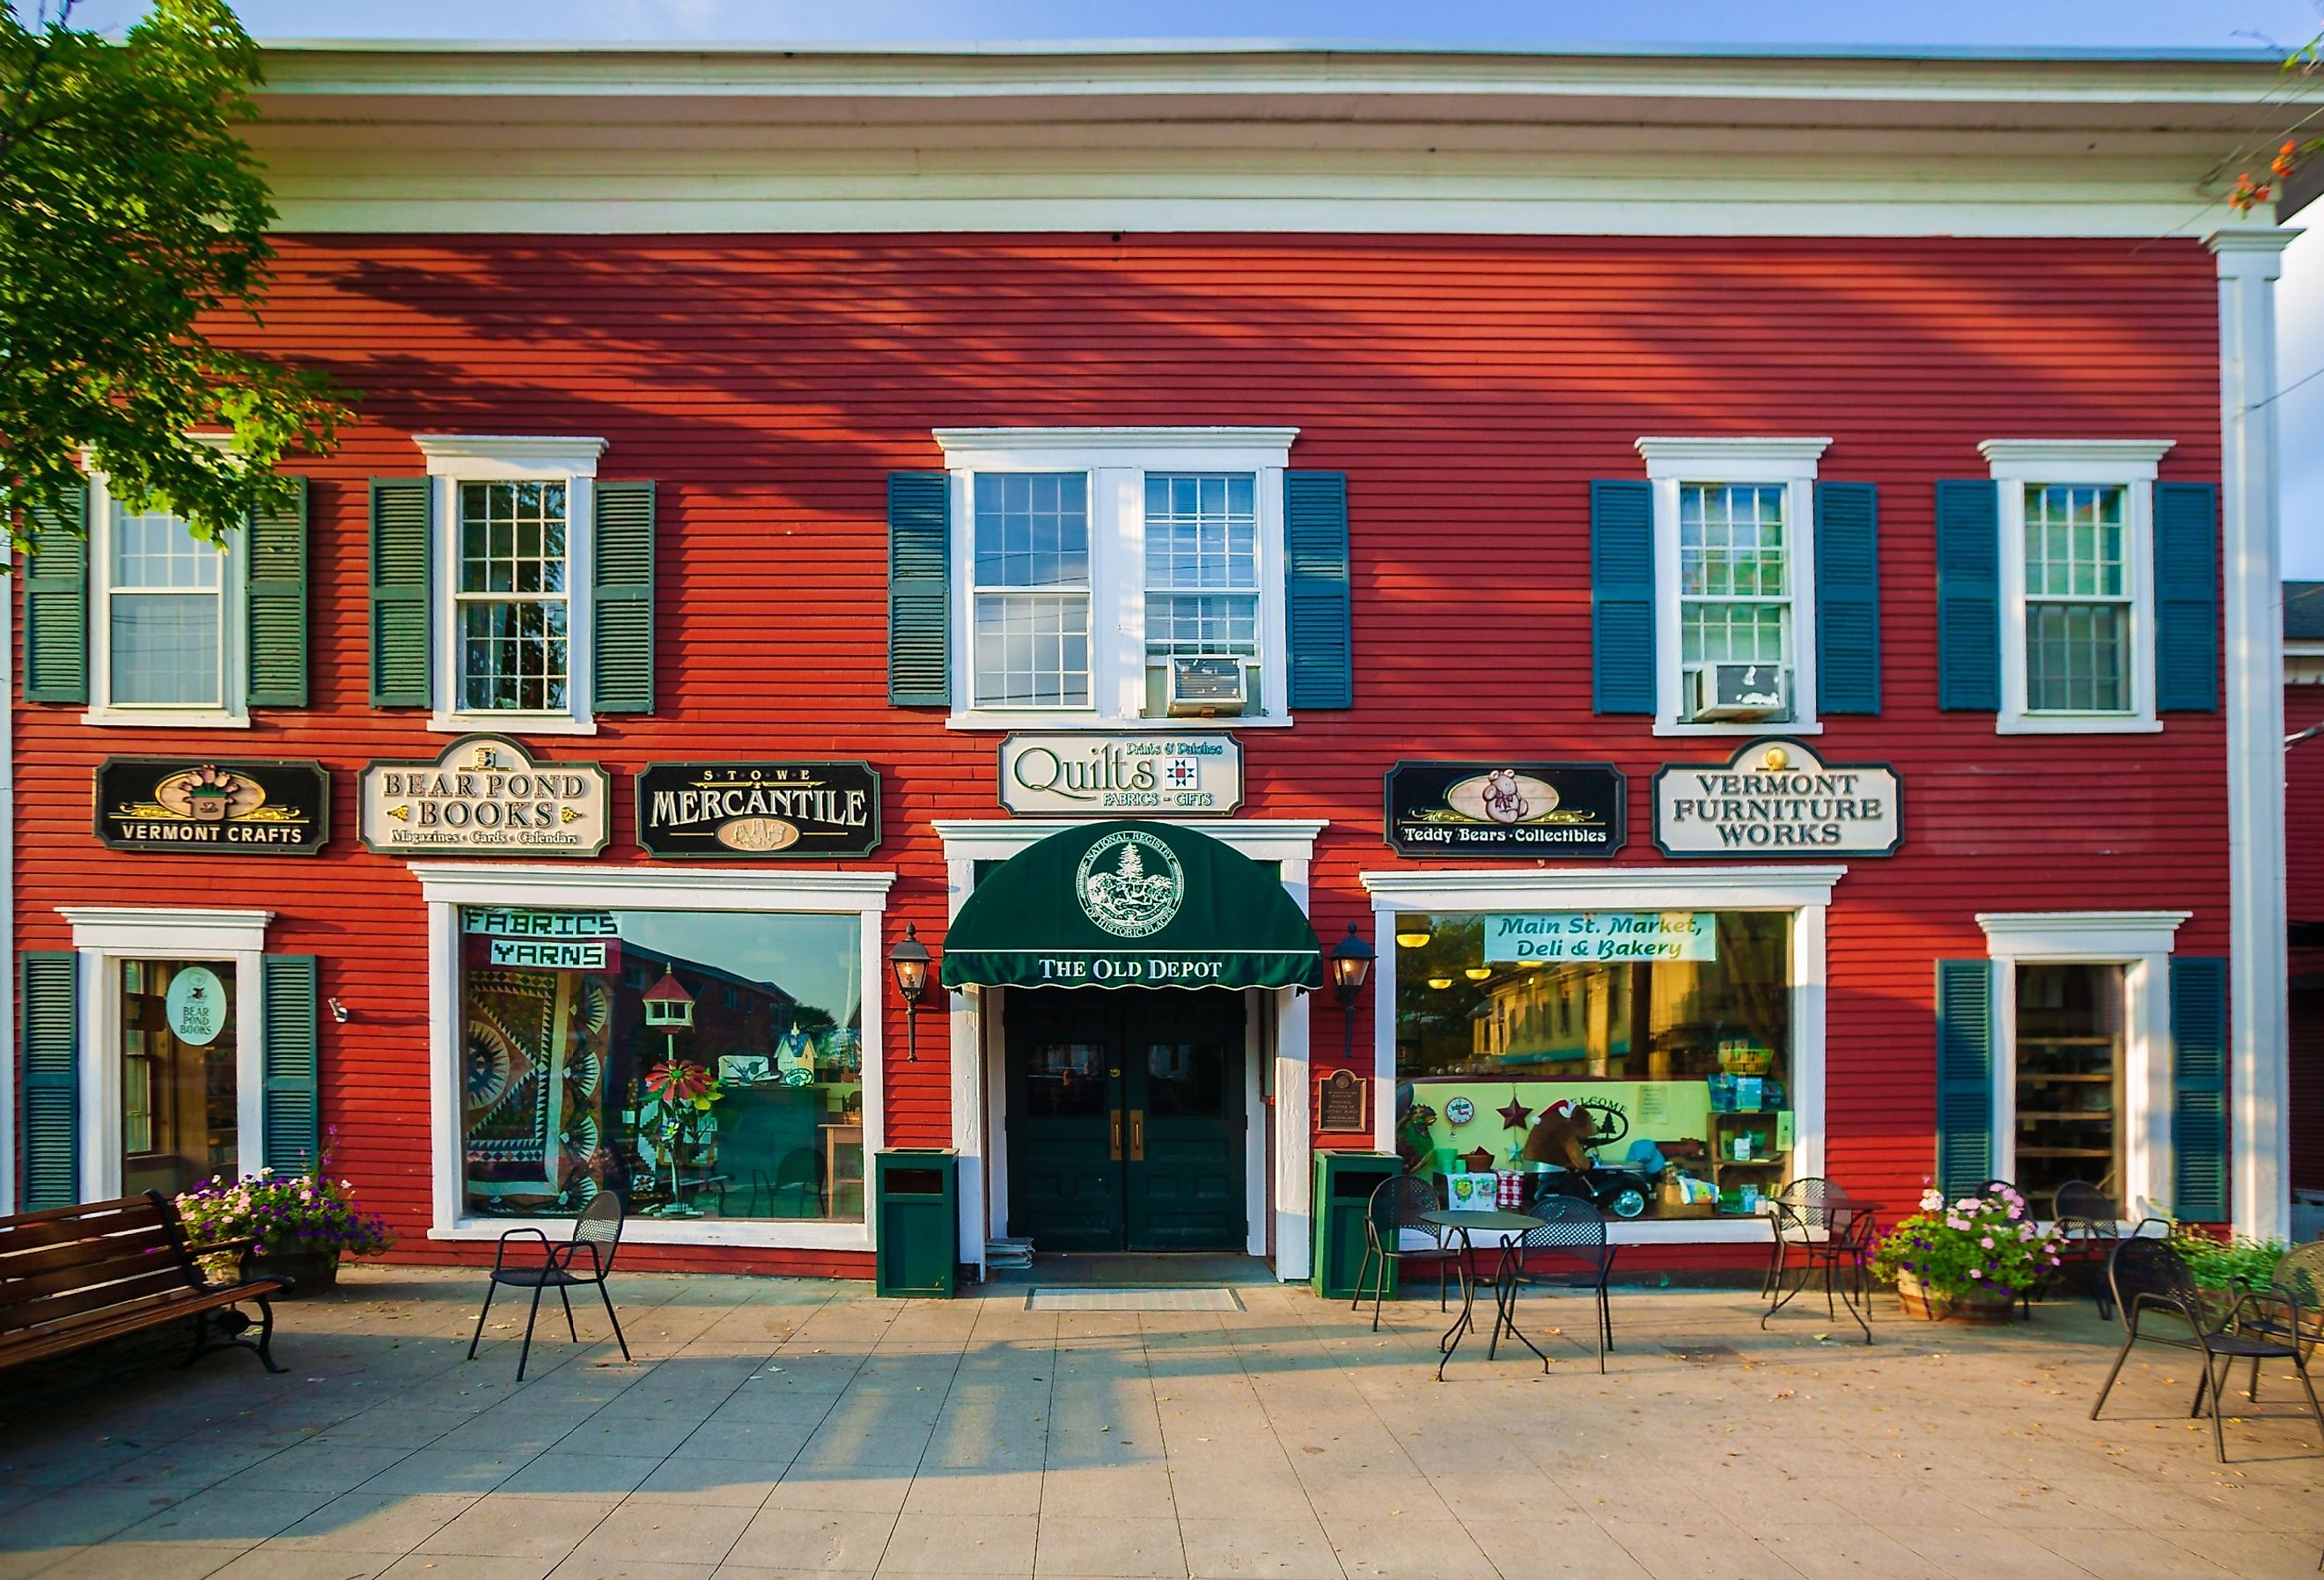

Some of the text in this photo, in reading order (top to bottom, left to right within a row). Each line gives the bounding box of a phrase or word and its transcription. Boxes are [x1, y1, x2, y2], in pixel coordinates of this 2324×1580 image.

[1126, 742, 1160, 755] Prints
[1177, 741, 1224, 755] Patches
[1013, 742, 1156, 801] Quilts
[383, 773, 585, 799] BEAR POND
[1695, 774, 1859, 796] VERMONT
[649, 790, 868, 827] MERCANTILE
[1102, 793, 1158, 806] FABRICS
[1173, 792, 1212, 806] GIFTS
[417, 800, 554, 828] BOOKS
[1673, 798, 1883, 822] FURNITURE
[121, 824, 303, 843] VERMONT CRAFTS
[392, 829, 577, 845] Magazines Cards Calendars
[1403, 827, 1607, 844] Teddy Bears Collectibles
[1715, 823, 1842, 847] WORKS
[1085, 833, 1175, 861] NATIONAL REGISTRY
[465, 911, 619, 935] FABRICS
[1097, 917, 1144, 936] HISTORIC
[1145, 908, 1176, 934] PLACES
[1497, 917, 1703, 937] Main St. Market,
[494, 944, 602, 966] YARNS
[1517, 939, 1682, 960] Deli & Bakery
[1039, 959, 1223, 980] THE OLD DEPOT
[183, 1006, 210, 1017] BEAR
[183, 1016, 210, 1025] POND
[180, 1025, 211, 1035] BOOKS
